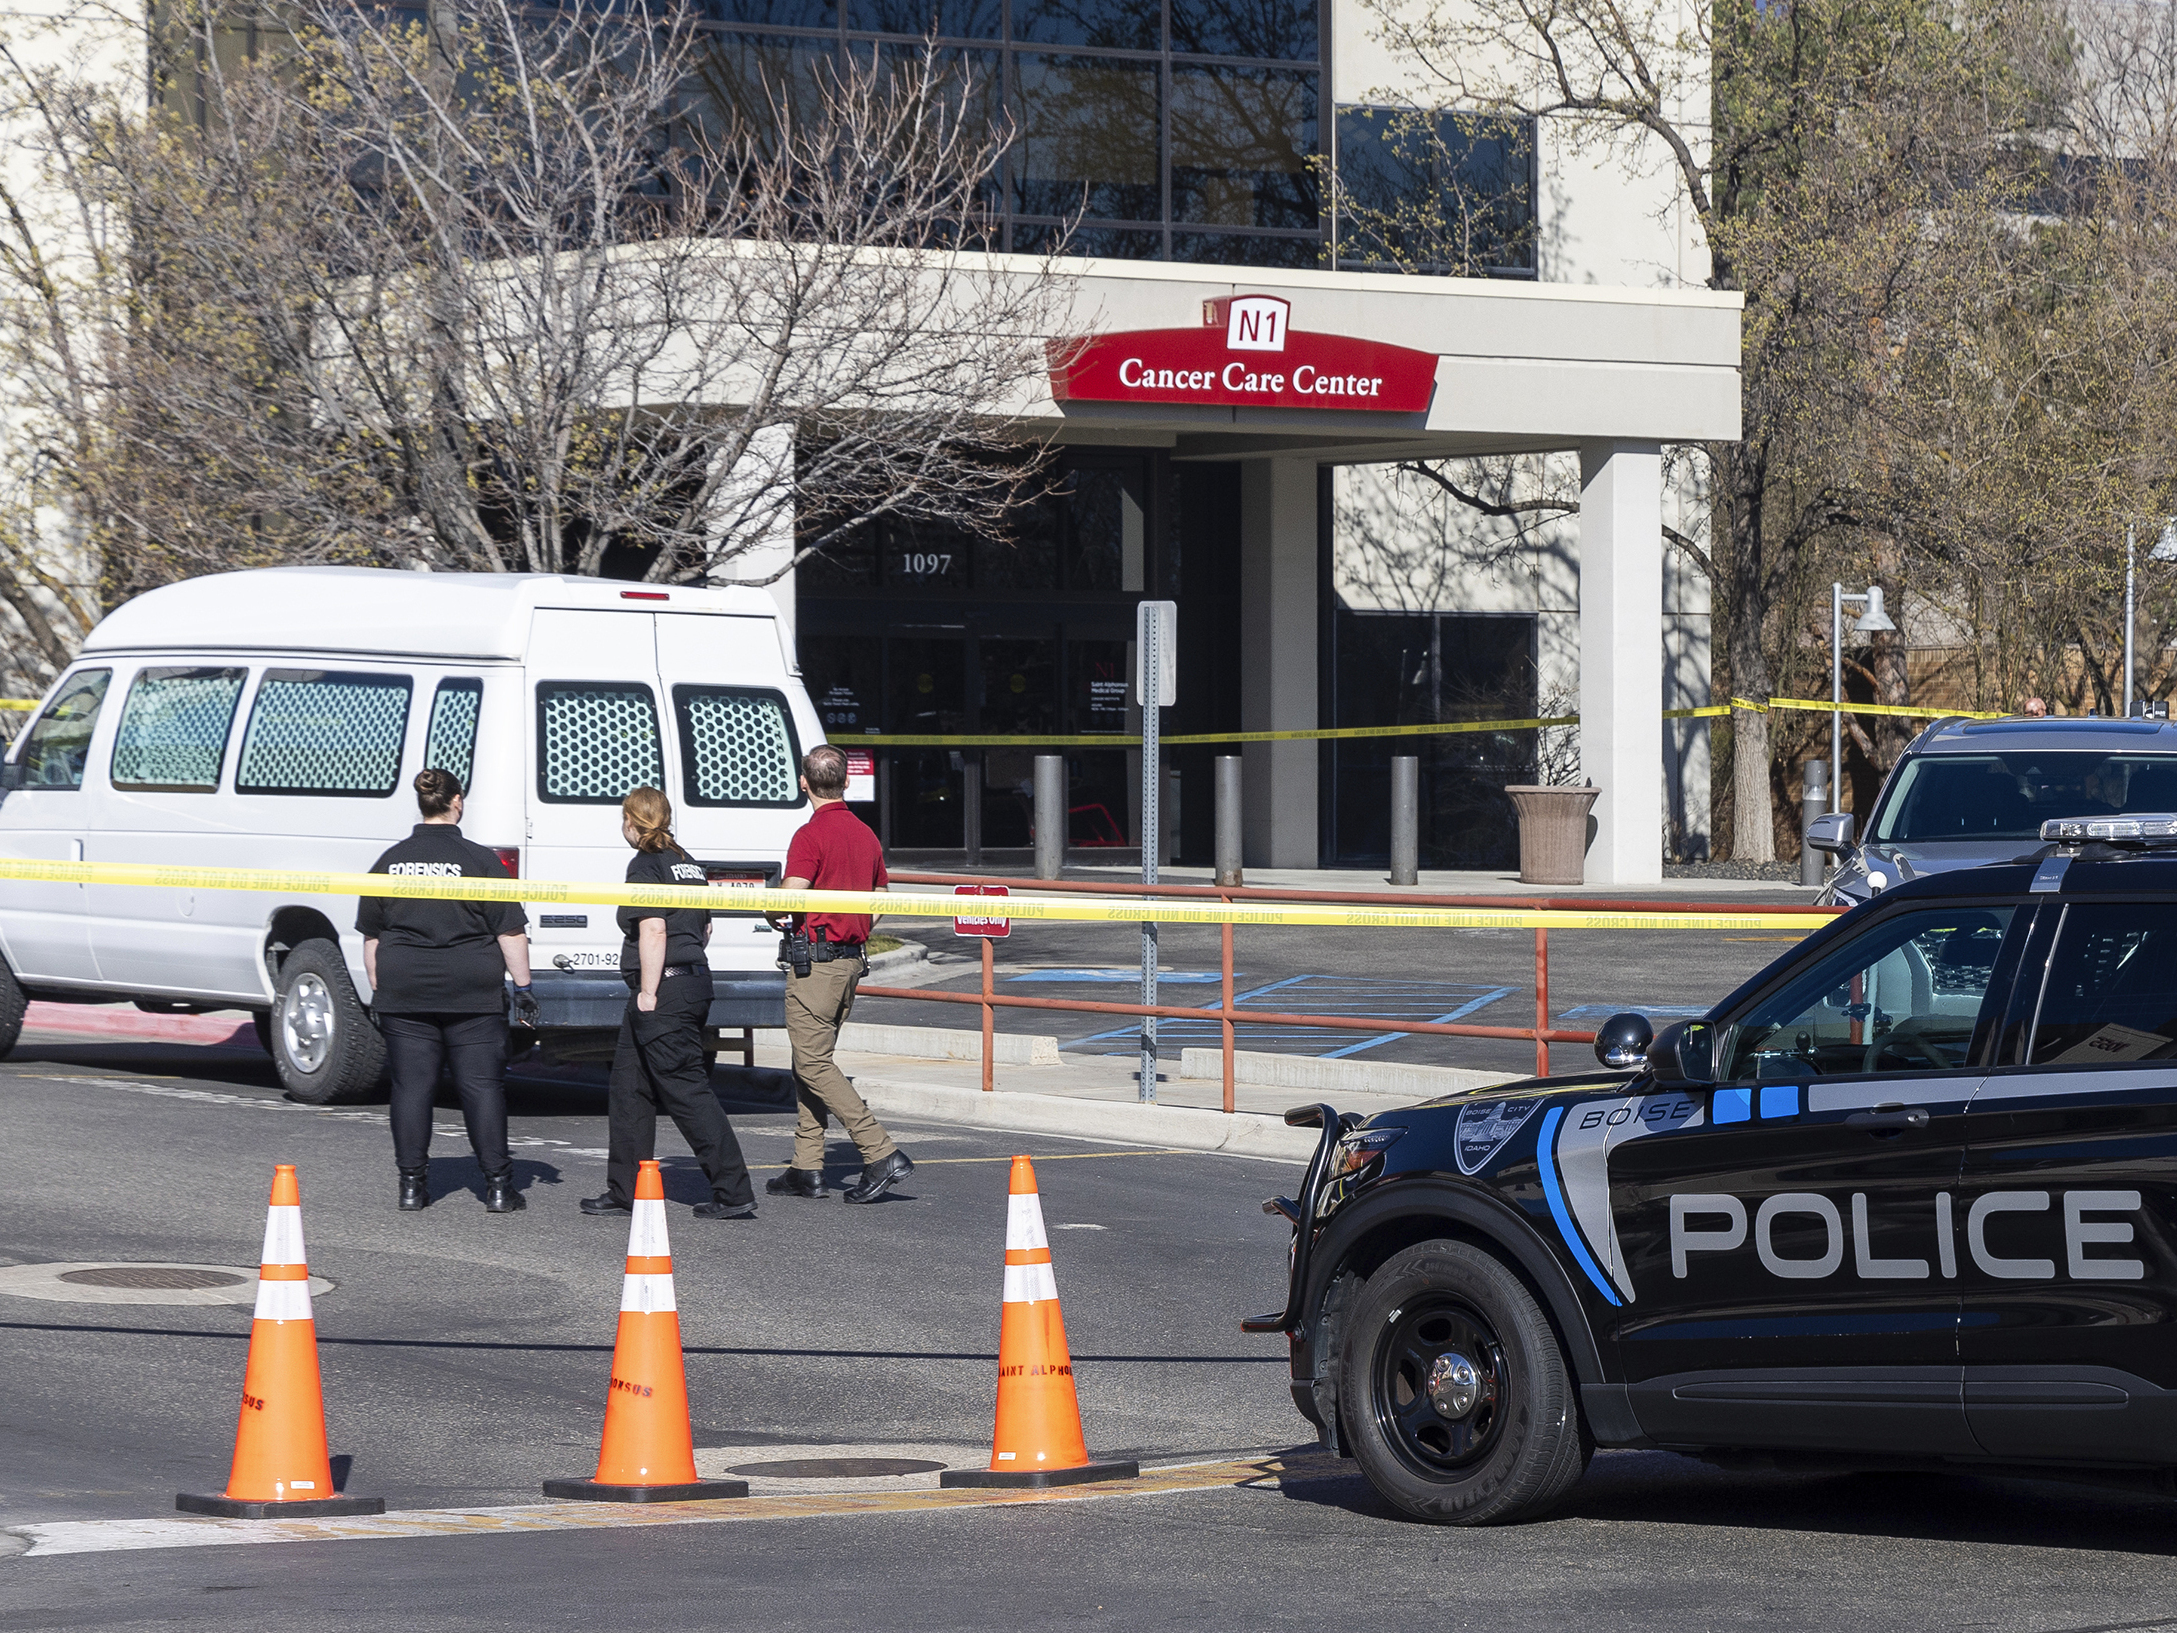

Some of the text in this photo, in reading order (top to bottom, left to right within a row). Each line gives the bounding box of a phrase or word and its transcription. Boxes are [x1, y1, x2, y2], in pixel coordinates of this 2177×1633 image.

[1239, 309, 1276, 343] N1
[1118, 358, 1382, 396] Cancer Care Center
[903, 553, 952, 575] 1097
[388, 862, 462, 877] FORENSICS
[989, 916, 1007, 928] Only
[1466, 1105, 1530, 1116] BOISE CITY
[1579, 1101, 1696, 1130] BOISE
[1670, 1191, 2144, 1280] POLICE
[243, 1391, 265, 1411] SUS
